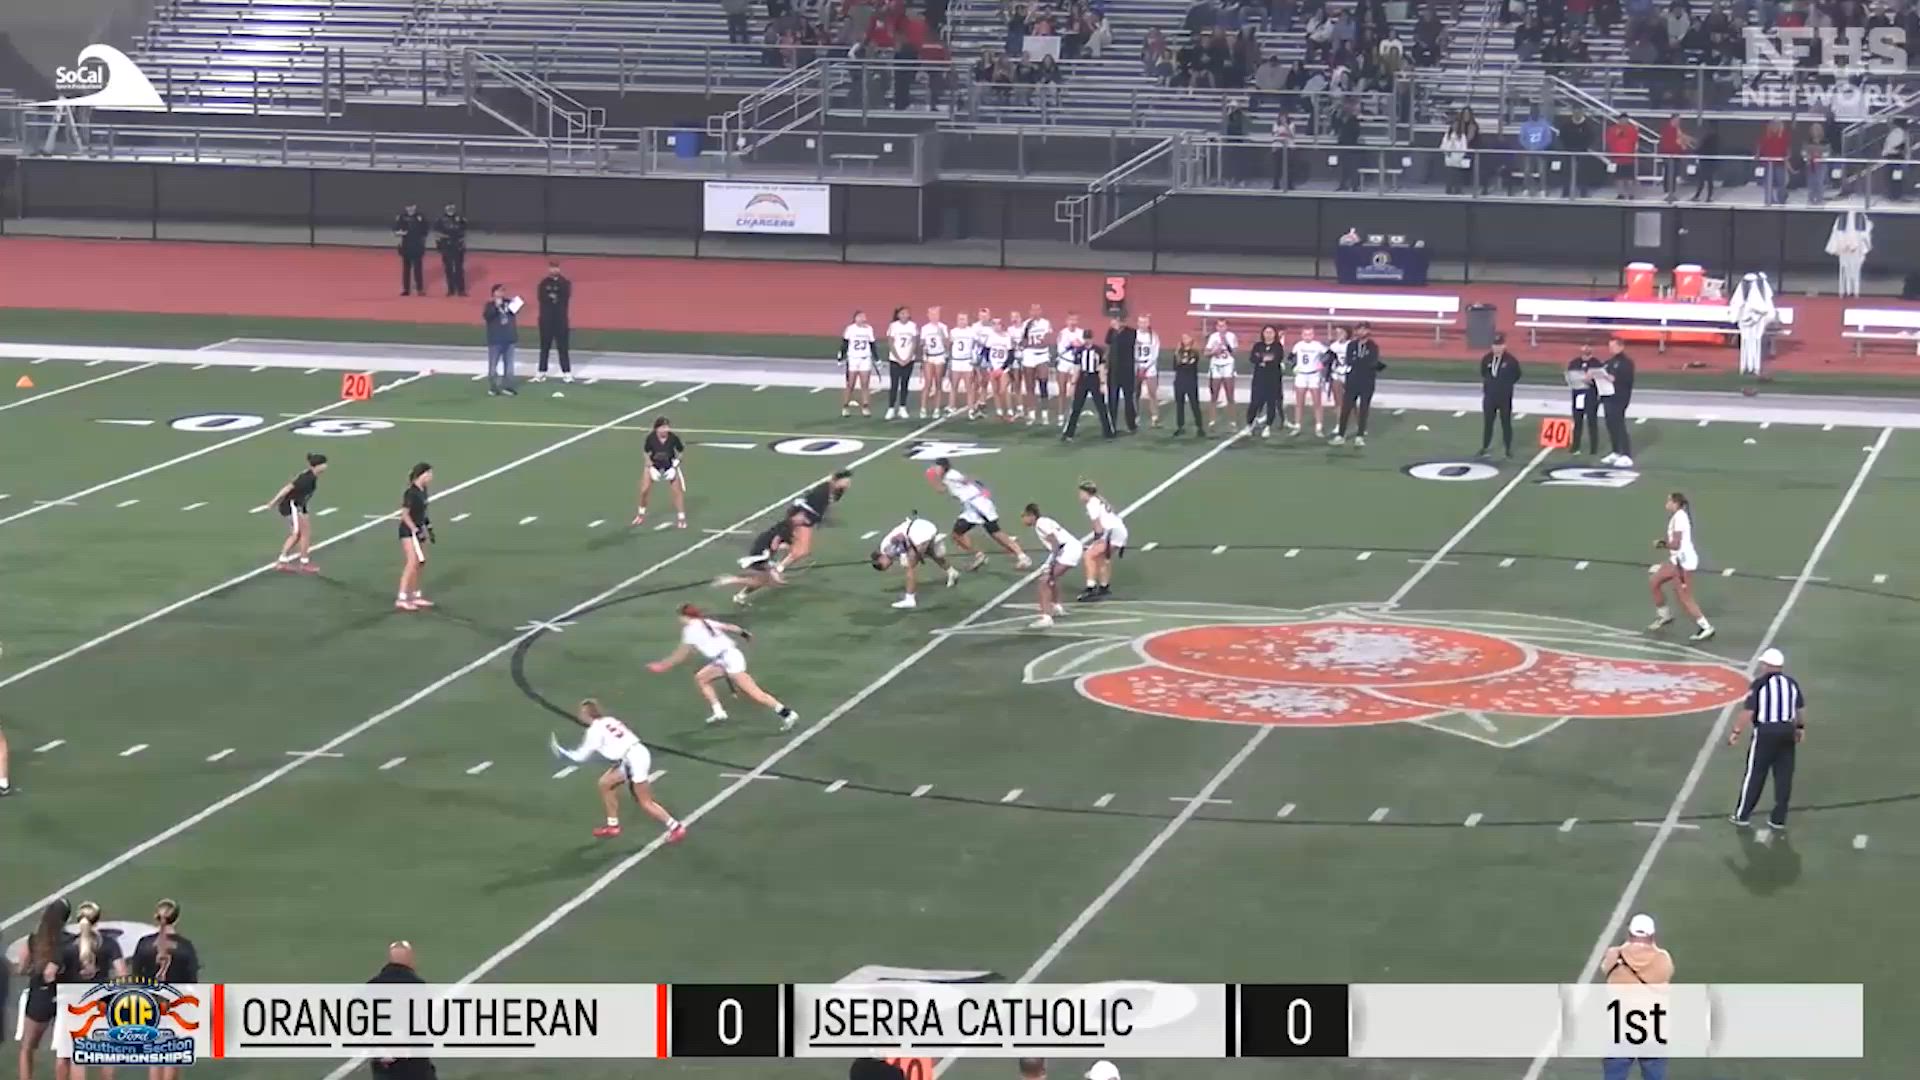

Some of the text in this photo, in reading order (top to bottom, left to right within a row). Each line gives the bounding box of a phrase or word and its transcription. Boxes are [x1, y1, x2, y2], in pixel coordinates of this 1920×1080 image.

[1106, 277, 1125, 301] 3
[854, 340, 867, 350] 23
[1137, 346, 1150, 357] 19
[1302, 354, 1309, 365] 6
[343, 375, 366, 398] 20
[1543, 421, 1567, 444] 40
